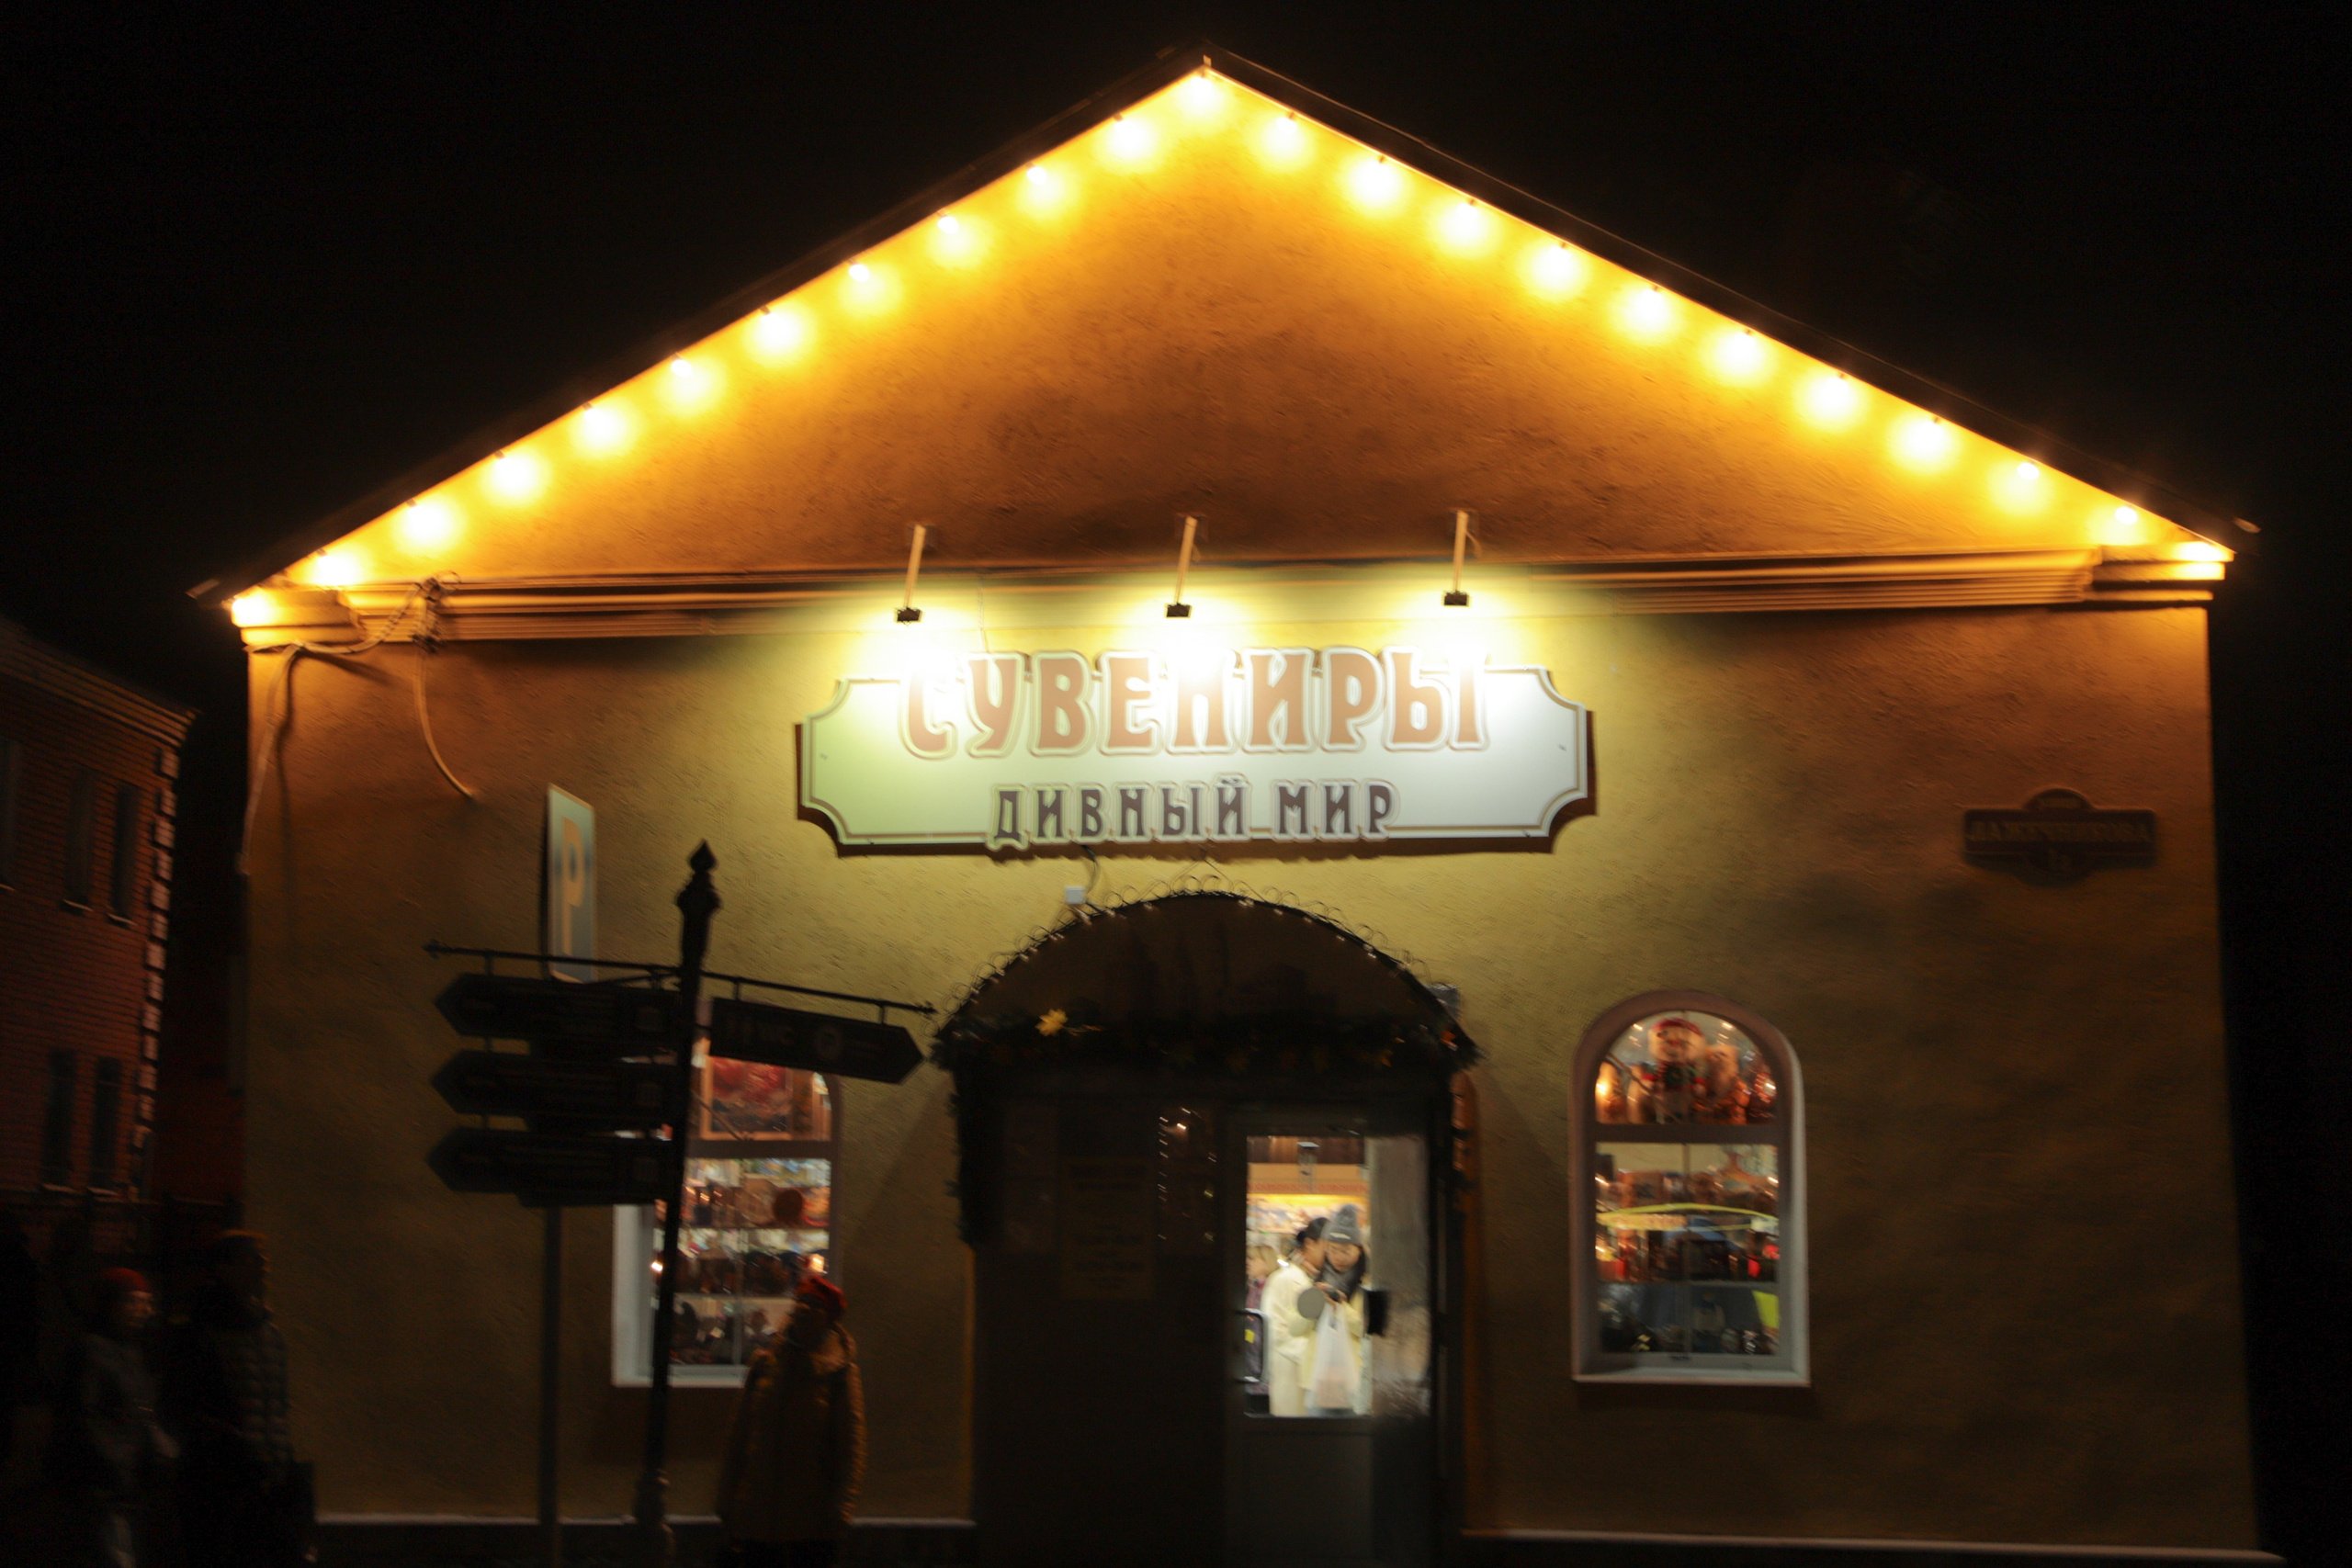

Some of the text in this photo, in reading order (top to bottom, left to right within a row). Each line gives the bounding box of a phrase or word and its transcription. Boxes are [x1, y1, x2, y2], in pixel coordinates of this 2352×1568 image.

[904, 649, 1487, 754] СУВЕНИРЫ
[991, 776, 1394, 843] ДИВНЫЙ МИР
[562, 816, 583, 954] P
